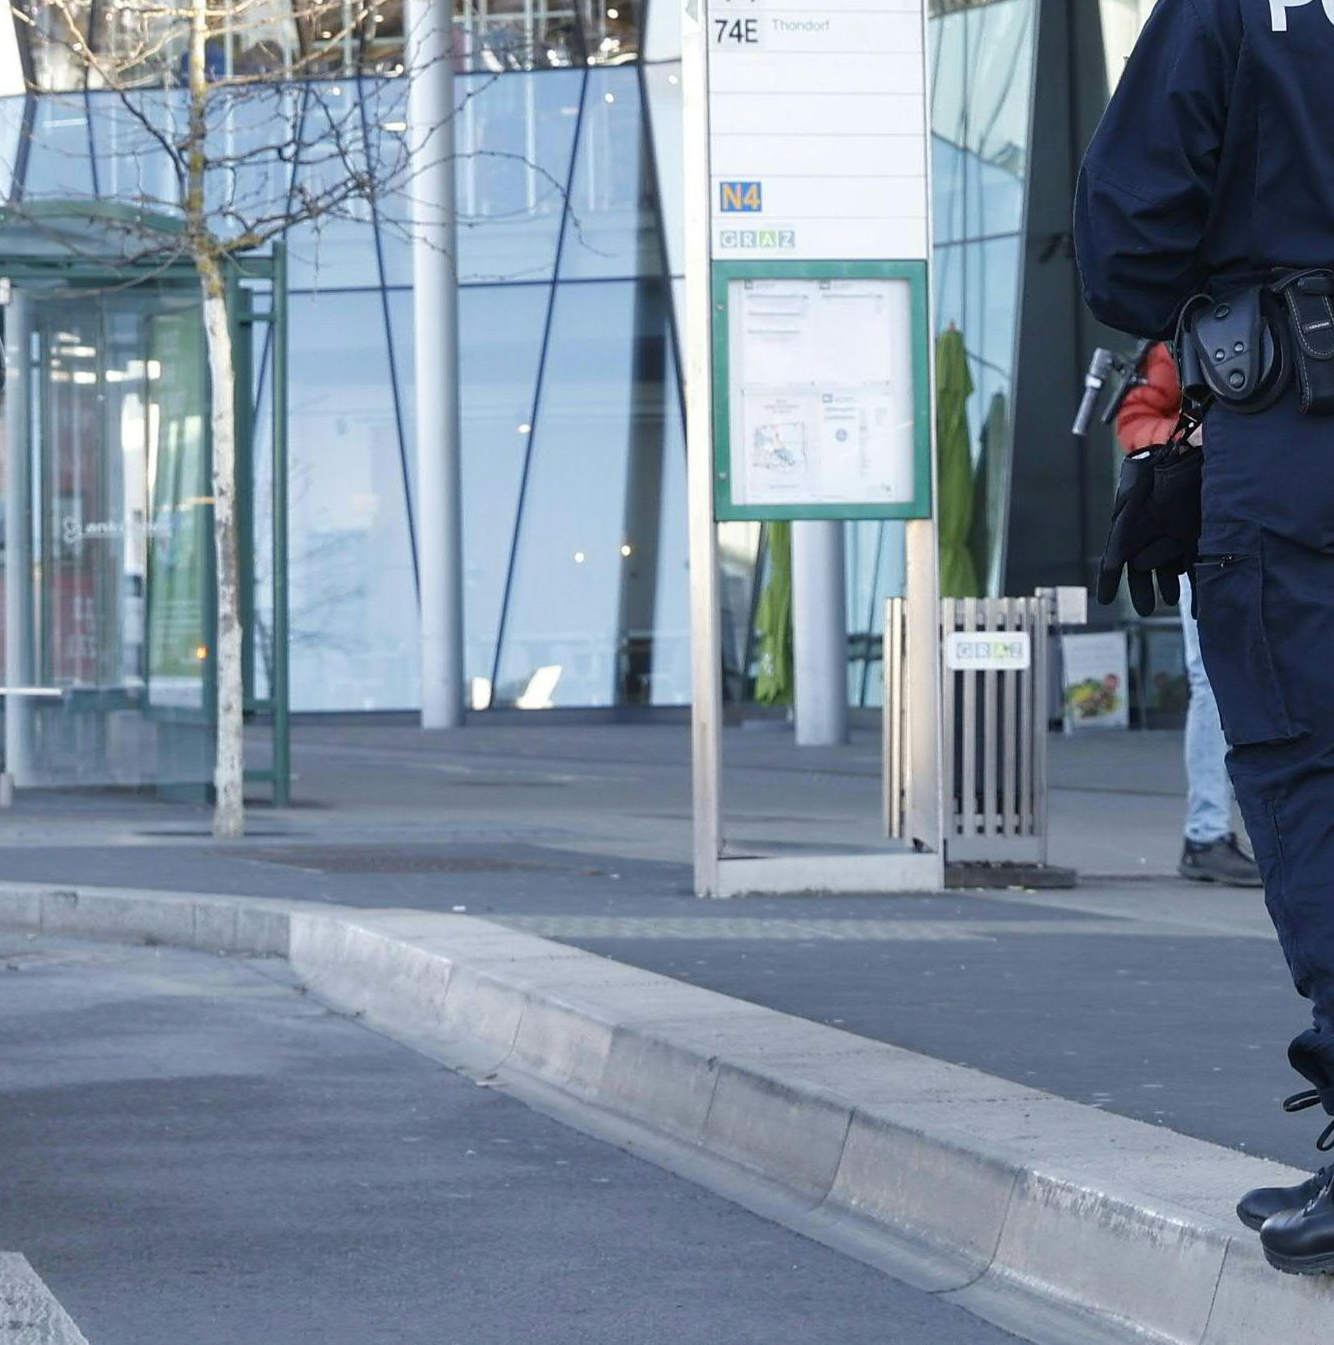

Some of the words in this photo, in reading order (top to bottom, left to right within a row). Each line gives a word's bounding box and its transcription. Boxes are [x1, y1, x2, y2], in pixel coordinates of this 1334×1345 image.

[715, 19, 759, 43] 74E
[772, 18, 830, 31] Thondorf
[721, 183, 761, 210] N4
[721, 230, 795, 249] GRAZ
